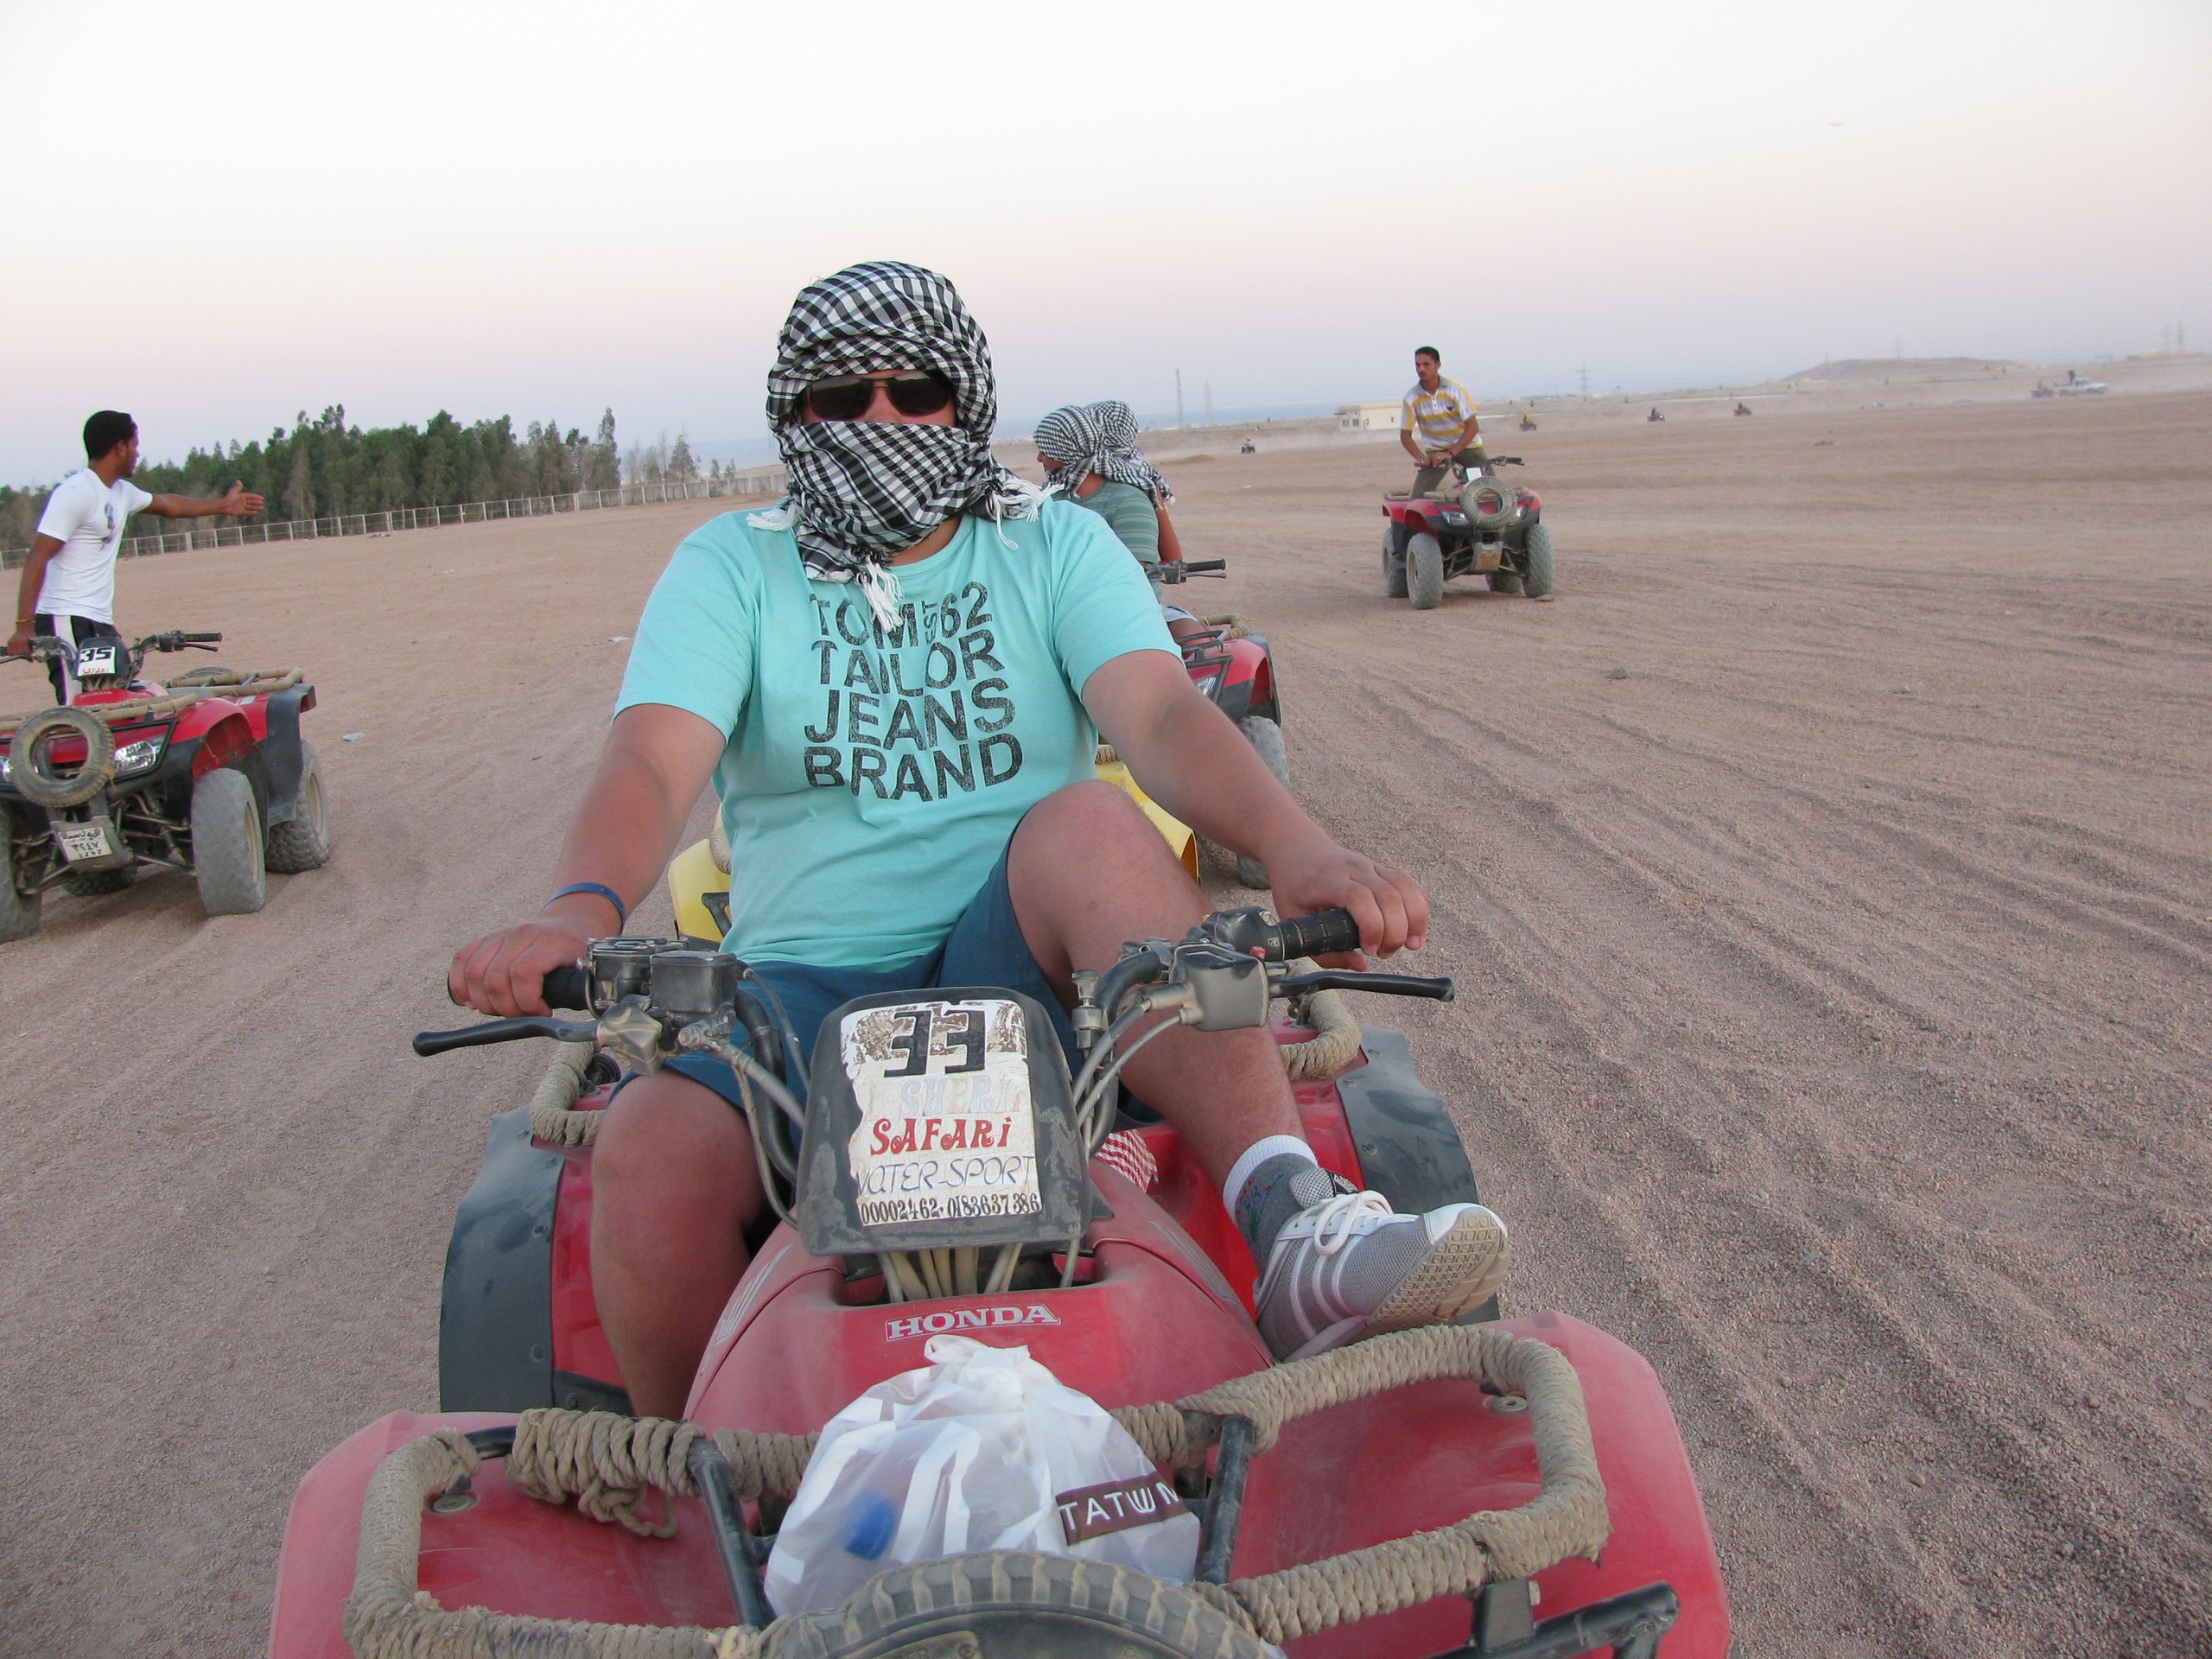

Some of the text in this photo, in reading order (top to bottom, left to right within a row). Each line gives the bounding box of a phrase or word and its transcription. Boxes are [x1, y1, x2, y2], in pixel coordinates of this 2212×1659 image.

[809, 593, 919, 650] TOM
[940, 581, 994, 639] 62
[79, 646, 113, 663] 35
[810, 628, 1006, 697] TAILOR
[804, 677, 1016, 751] JEANS
[803, 733, 1023, 802] BRAND
[883, 1009, 986, 1078] 33
[887, 1305, 1059, 1339] HONDA
